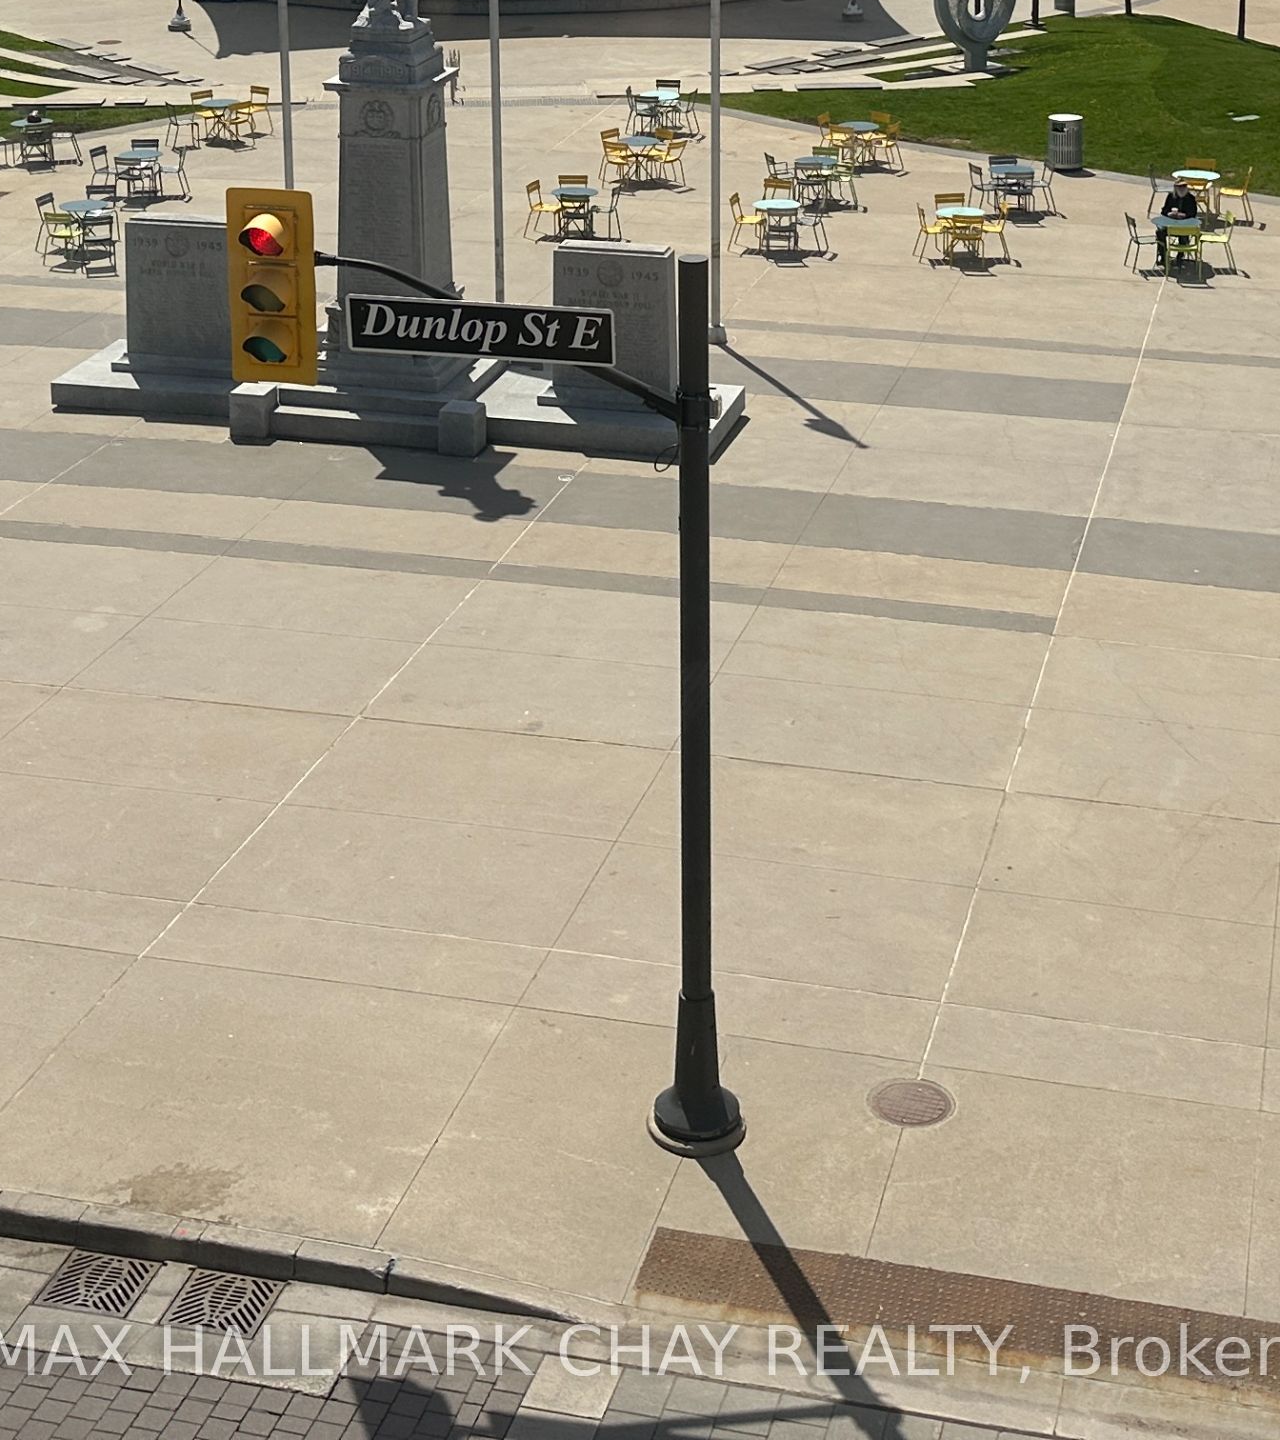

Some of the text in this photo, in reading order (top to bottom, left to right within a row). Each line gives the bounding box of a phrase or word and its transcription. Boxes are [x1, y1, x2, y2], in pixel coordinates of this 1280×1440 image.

[562, 265, 659, 282] 1939 1945
[360, 303, 508, 352] Dunlop
[517, 312, 561, 348] St
[568, 315, 603, 350] E
